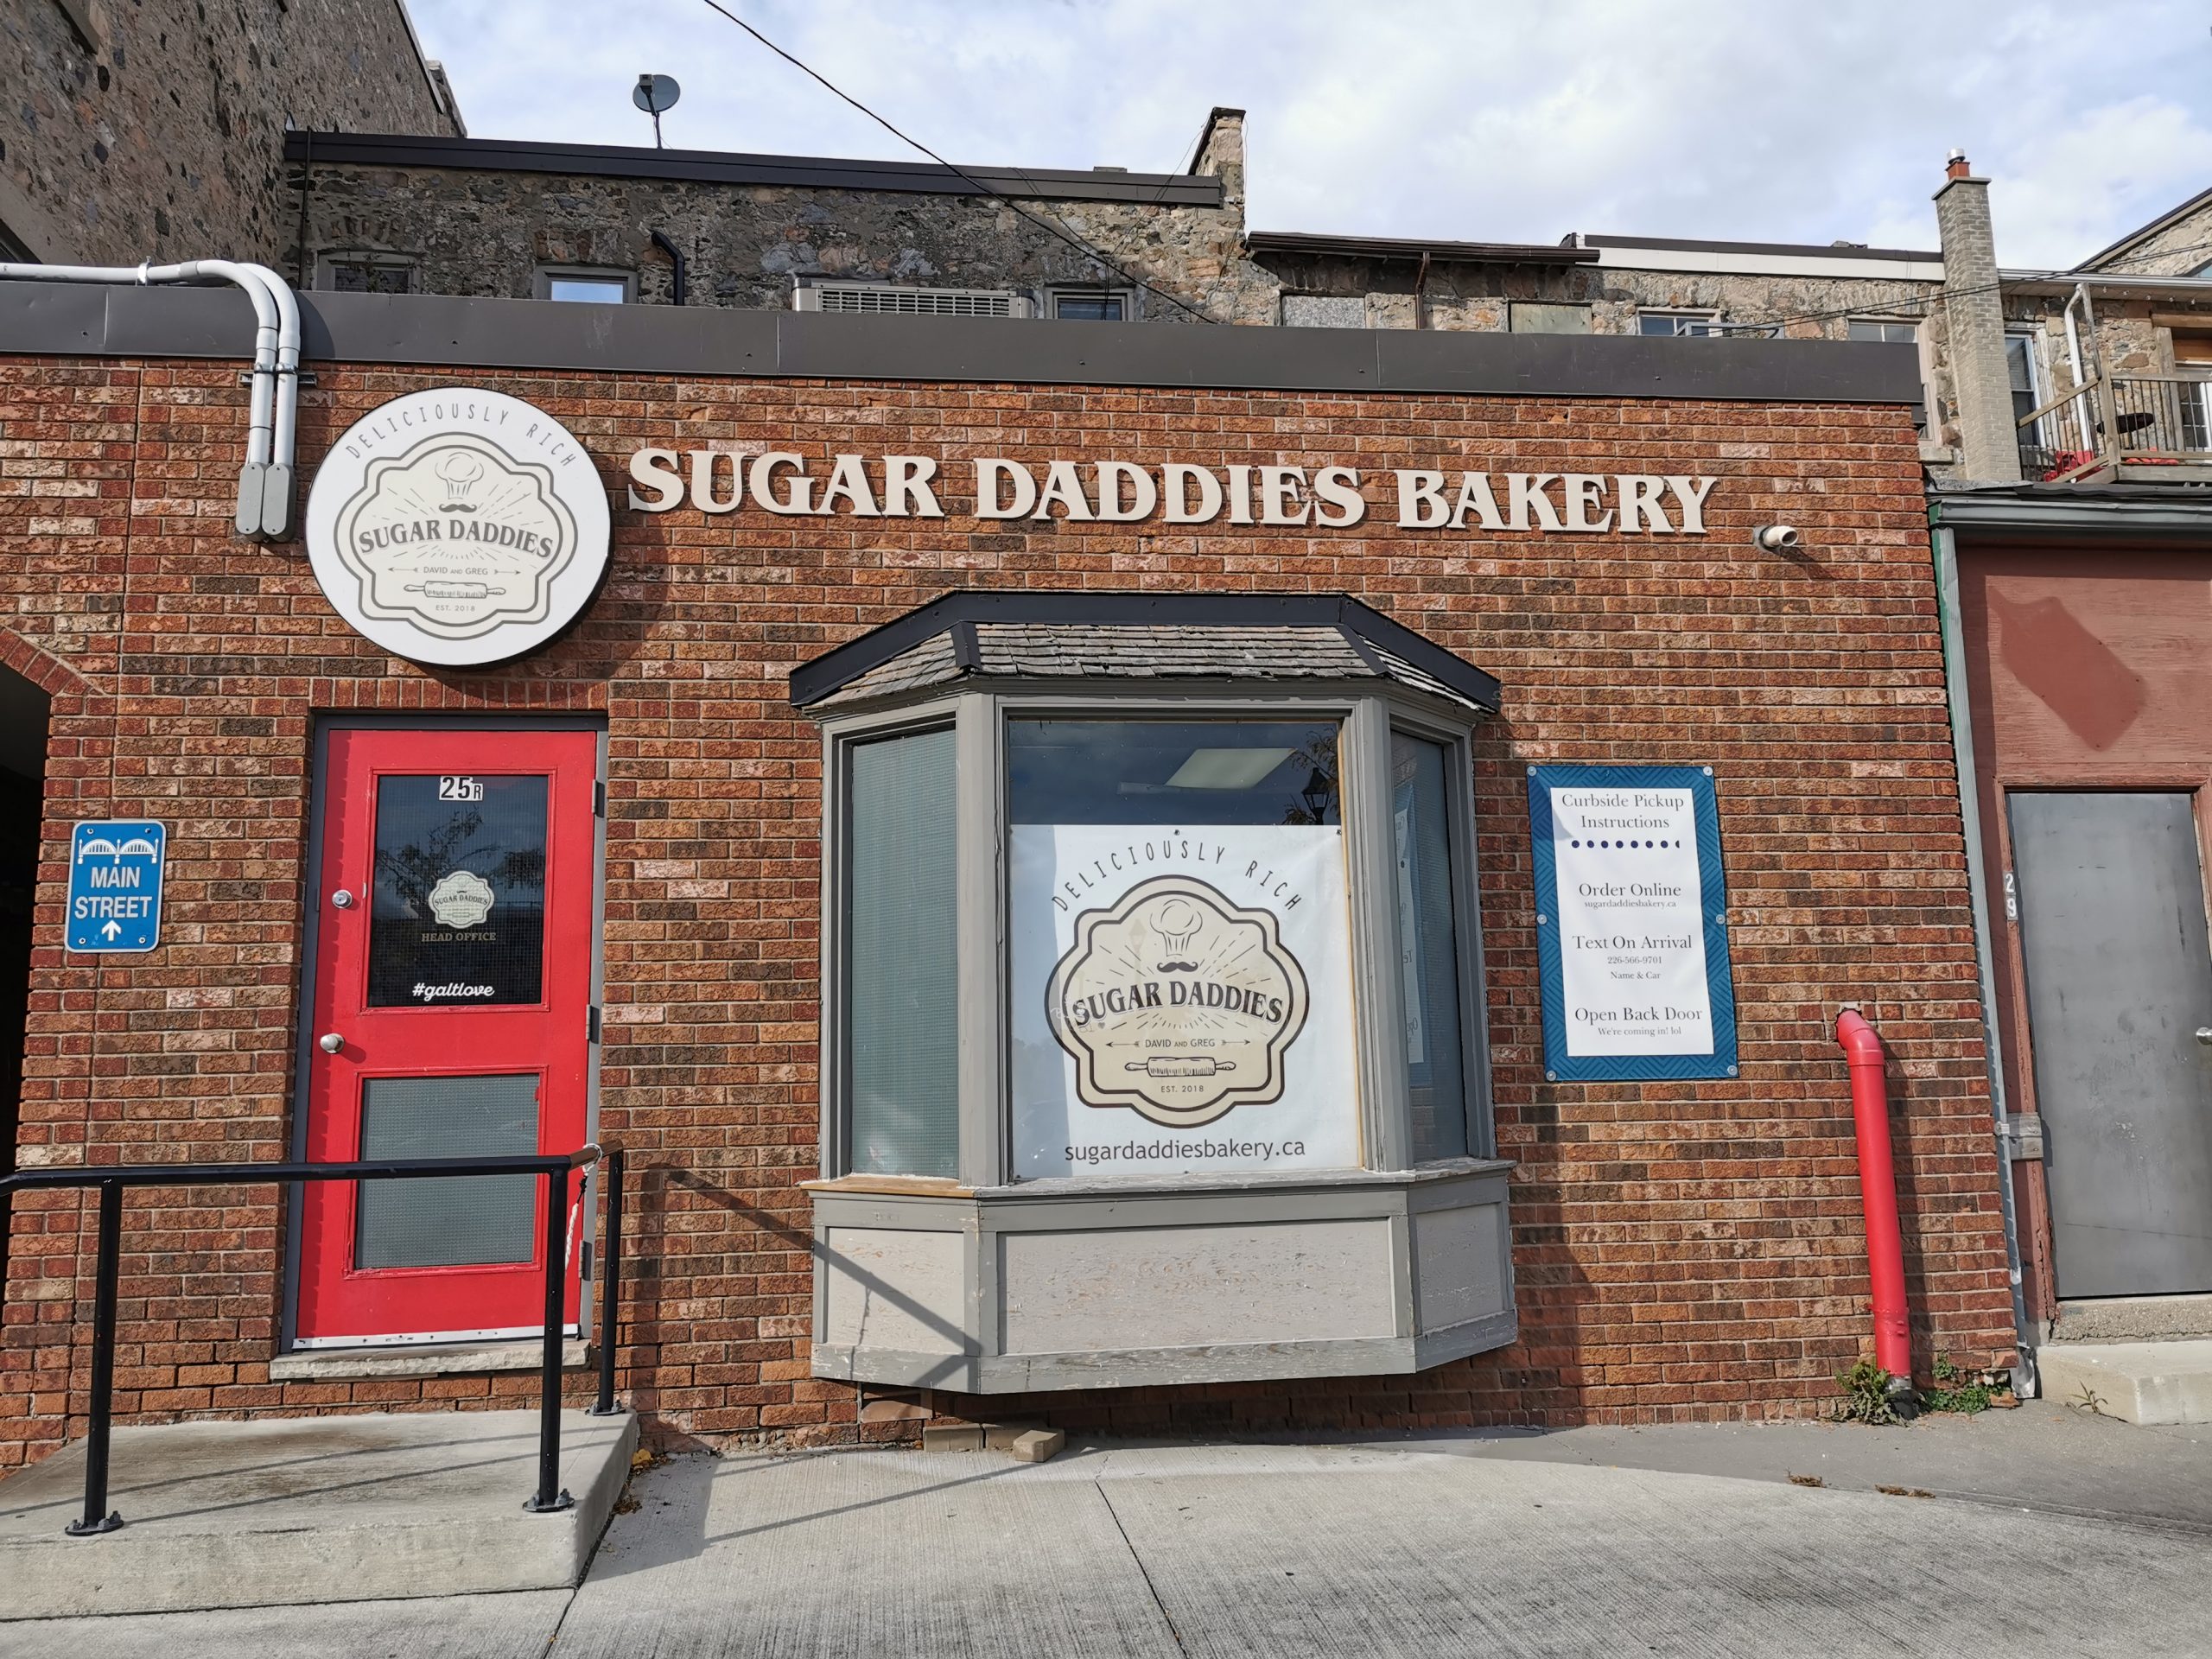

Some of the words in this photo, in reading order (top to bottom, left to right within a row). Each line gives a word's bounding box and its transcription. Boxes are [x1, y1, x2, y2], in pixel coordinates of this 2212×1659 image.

[346, 402, 509, 459] DELICIOUSLY
[525, 423, 576, 467] RICH
[628, 448, 944, 520] SUGAR
[972, 458, 1365, 528] DADDIES
[1395, 469, 1715, 535] BAKERY
[359, 519, 442, 554] SUGAR
[449, 519, 554, 558] DADDIES
[423, 566, 448, 575] DAVID
[465, 567, 488, 575] GREG
[1561, 793, 1629, 808] Curbside
[1634, 793, 1684, 811] Pickup
[1580, 815, 1670, 829] Instructions
[91, 867, 141, 888] MAIN
[1051, 840, 1225, 912] DELICIOUSLY
[1245, 860, 1302, 911] RICH
[1579, 883, 1626, 897] Order
[1630, 882, 1681, 897] Online
[74, 896, 152, 919] STREET
[435, 894, 458, 906] SUGAR
[459, 893, 488, 906] DADDIES
[1584, 899, 1676, 909] sugardaddiesbakery.ca
[422, 932, 453, 942] HEAD
[455, 932, 496, 941] OFFICE
[1572, 935, 1608, 950] Text
[1612, 935, 1636, 950] On
[1641, 935, 1692, 950] Arrival
[1607, 956, 1662, 964] 226-566-9701
[1610, 971, 1635, 980] Name
[1637, 971, 1643, 980] &
[1645, 971, 1661, 980] Car
[412, 982, 494, 1001] #galtlove
[1072, 981, 1162, 1027] SUGAR
[1168, 981, 1283, 1024] DADDIES
[1574, 1007, 1617, 1026] Open
[1623, 1007, 1660, 1021] Back
[1664, 1007, 1703, 1020] Door
[1598, 1027, 1622, 1036] We're
[1624, 1027, 1656, 1038] coming
[1670, 1027, 1681, 1035] lol
[1145, 1039, 1172, 1048] DAVID
[1190, 1038, 1216, 1048] GREG
[1065, 1138, 1306, 1165] sugardaddiesbakery.ca
